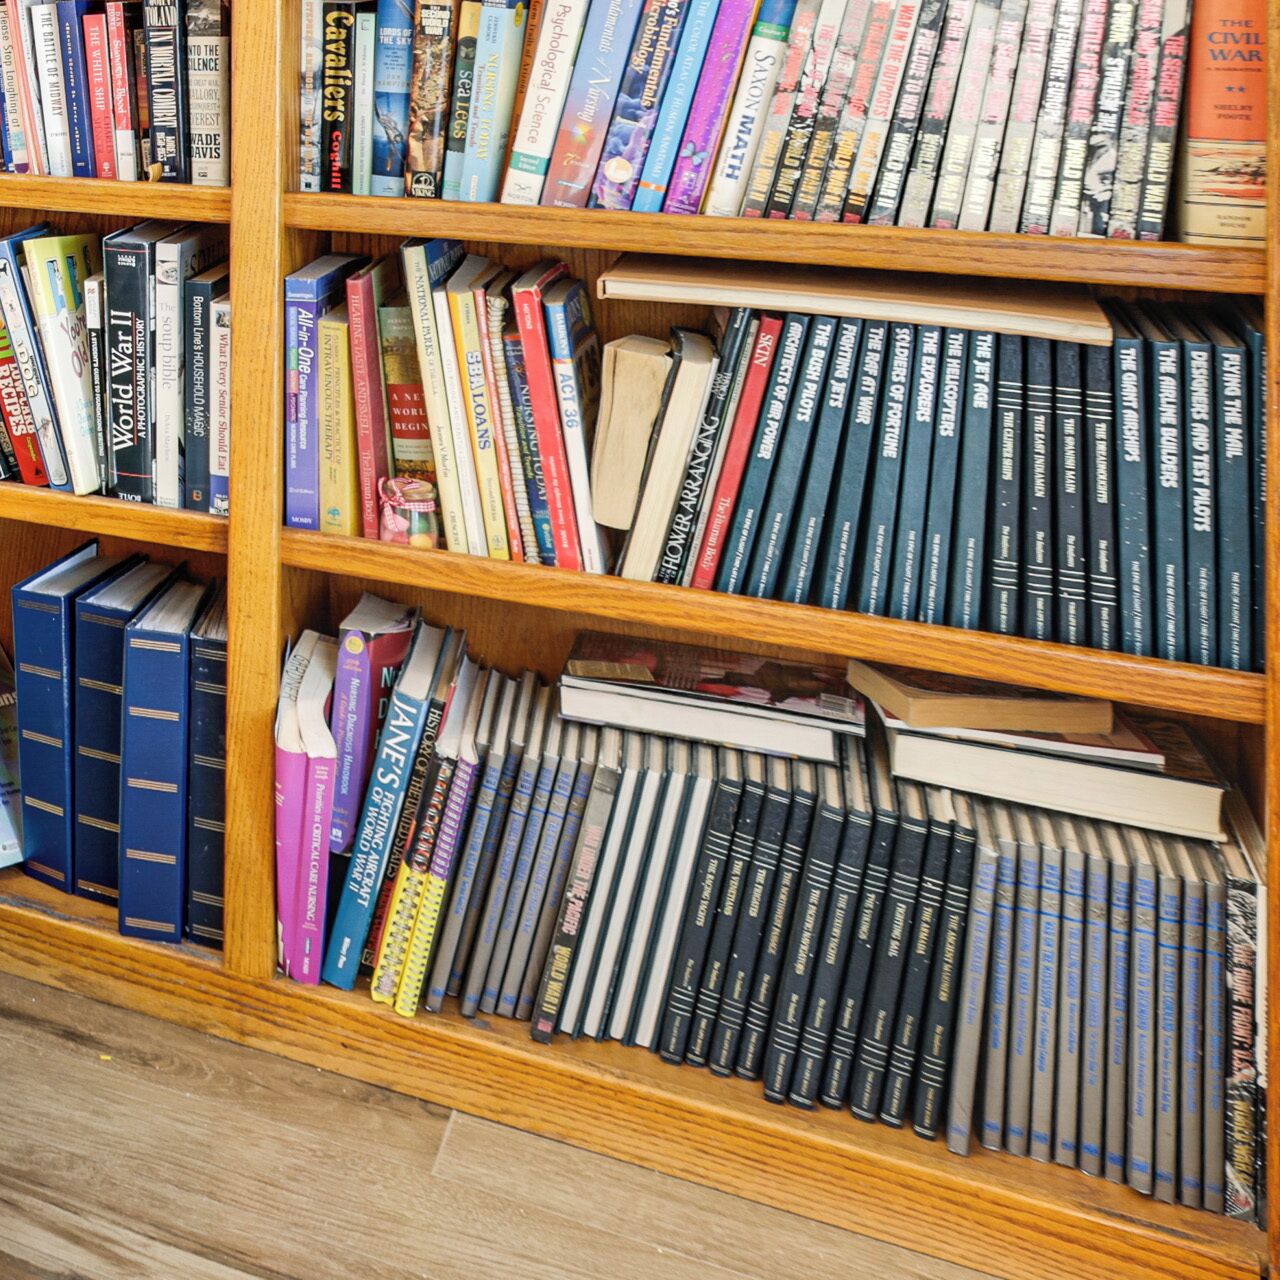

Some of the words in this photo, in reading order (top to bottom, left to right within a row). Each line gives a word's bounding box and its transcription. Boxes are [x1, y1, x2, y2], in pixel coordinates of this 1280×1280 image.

[41, 12, 51, 27] THE
[43, 32, 56, 63] BATTLE
[540, 4, 569, 91] Psychological
[1166, 36, 1185, 55] THE
[48, 68, 58, 78] OF
[325, 11, 355, 122] Cavaliers
[745, 50, 776, 112] SAXON
[1161, 58, 1184, 98] SECRET
[49, 81, 63, 117] MIDWAY
[1156, 101, 1180, 126] WAR
[527, 96, 550, 144] Science
[725, 114, 755, 181] MATH
[1149, 142, 1171, 181] WORLD
[1146, 185, 1165, 209] WAR
[1142, 212, 1161, 223] II
[111, 310, 131, 326] II
[193, 296, 204, 325] Bottom
[159, 316, 175, 351] soup
[194, 328, 204, 350] Line's
[219, 334, 228, 358] What
[297, 308, 314, 373] All-in-One
[977, 334, 992, 358] THE
[111, 331, 133, 377] War
[754, 333, 772, 367] SKIN
[775, 322, 802, 384] ARCHITECTS
[891, 328, 911, 383] SOLDIERS
[162, 355, 177, 389] bible
[194, 351, 204, 404] HOUSEHOLD
[218, 361, 228, 387] Every
[467, 351, 484, 390] SBA
[973, 360, 990, 381] JET
[1191, 351, 1207, 420] DESIGNERS
[1222, 354, 1241, 396] FLYING
[218, 389, 228, 416] Senior
[773, 385, 789, 399] OF
[889, 386, 903, 400] OF
[973, 383, 989, 408] AGE
[112, 384, 134, 451] World
[194, 406, 204, 436] MAGIC
[472, 393, 491, 450] LOANS
[768, 400, 786, 419] AIR
[1224, 399, 1240, 424] THE
[218, 418, 228, 451] Should
[757, 420, 780, 459] POWER
[882, 402, 901, 458] FORTUNE
[1064, 419, 1075, 435] THE
[1192, 423, 1208, 451] AND
[1064, 437, 1075, 469] SPANISH
[1227, 428, 1242, 458] MAIL
[218, 453, 228, 470] Eat
[1193, 454, 1208, 484] TEST
[1065, 471, 1076, 493] MAIN
[1193, 488, 1210, 532] PILOTS
[377, 696, 418, 786] JANE'S
[367, 787, 382, 803] OF
[358, 803, 379, 851] WORLD
[373, 791, 393, 851] FIGHTING
[312, 824, 322, 861] CRITICAL
[309, 862, 319, 884] CARE
[353, 853, 370, 882] WAR
[356, 852, 380, 907] AIRCRAFT
[349, 881, 360, 892] II
[307, 886, 319, 921] NURSING
[920, 906, 933, 922] THE
[916, 924, 929, 954] ARMADA
